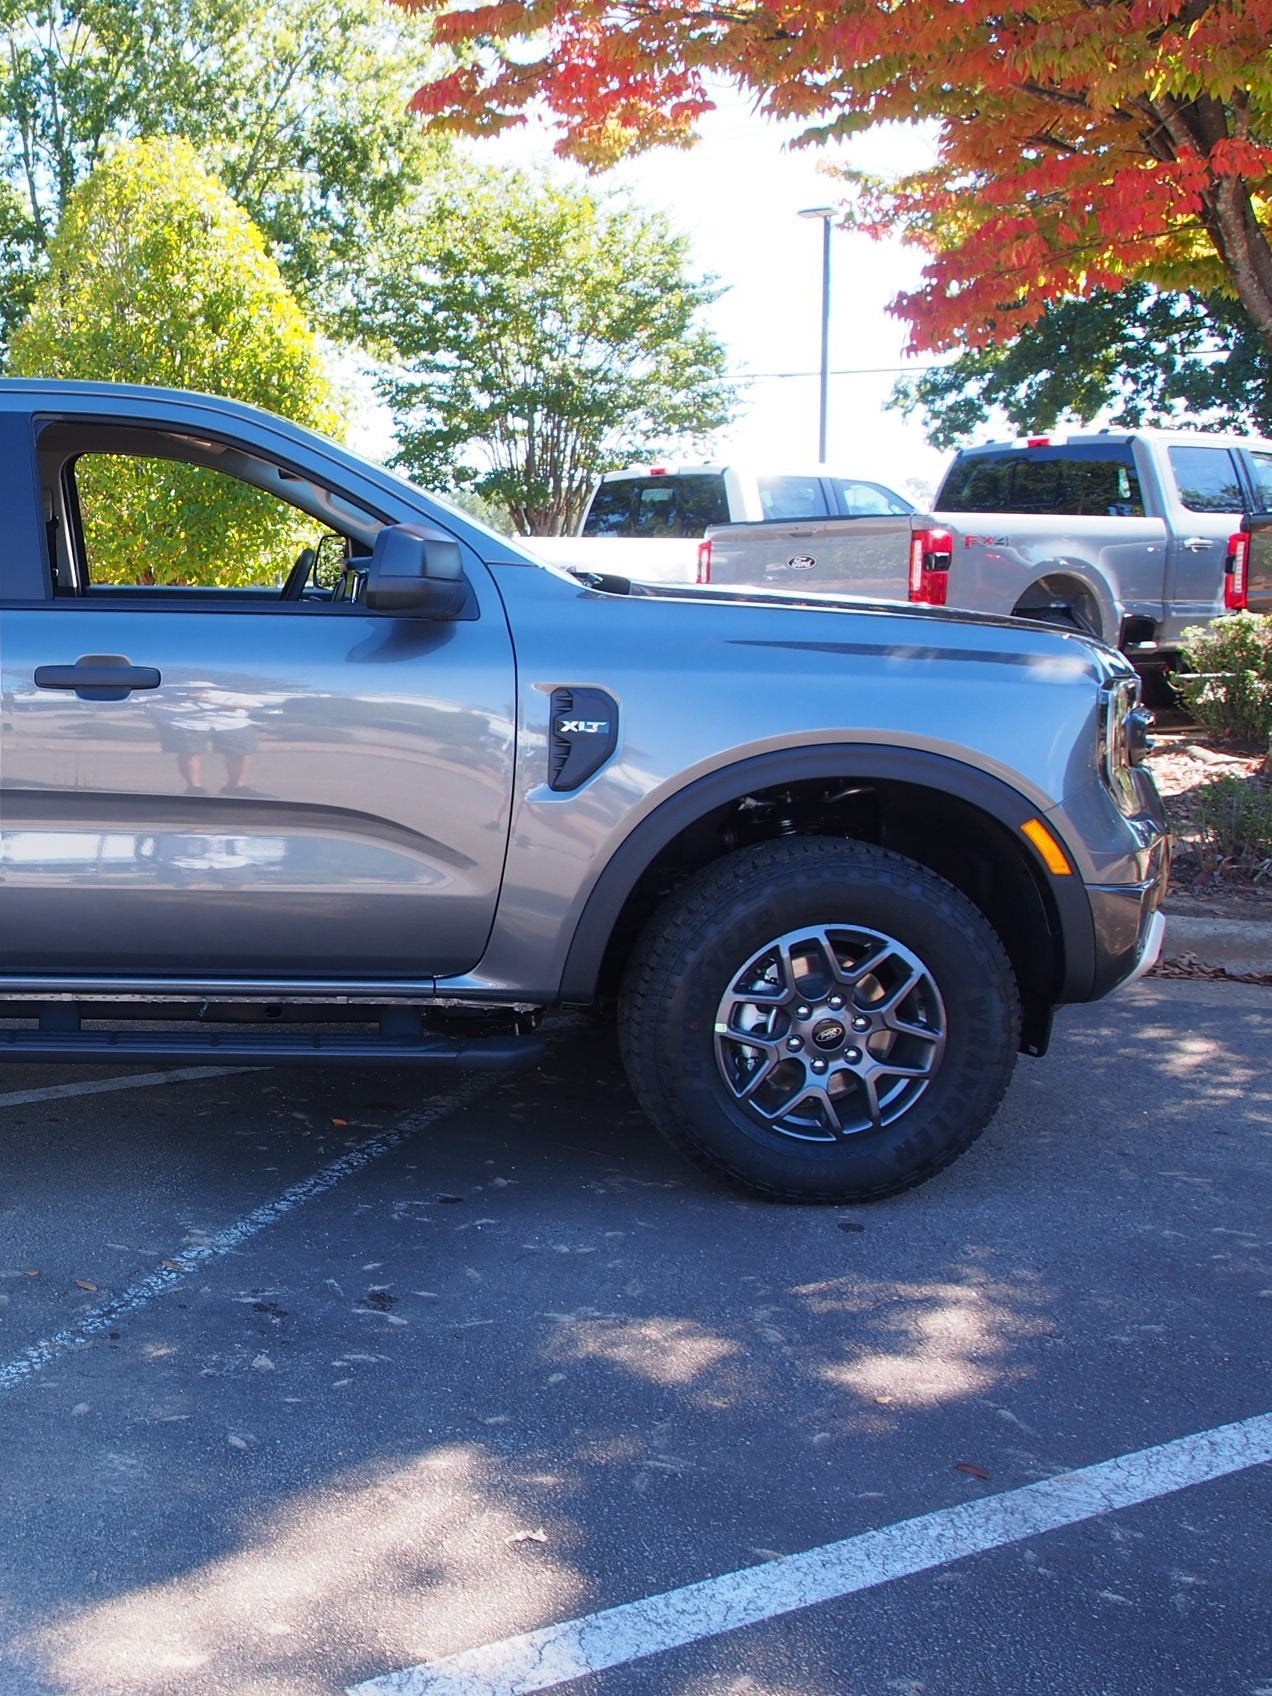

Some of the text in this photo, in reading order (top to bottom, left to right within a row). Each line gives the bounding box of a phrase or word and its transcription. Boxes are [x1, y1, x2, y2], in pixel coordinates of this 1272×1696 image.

[964, 535, 1009, 547] FX4
[790, 556, 814, 569] Ford
[560, 720, 608, 733] XLT
[894, 995, 990, 1166] WRANGLER
